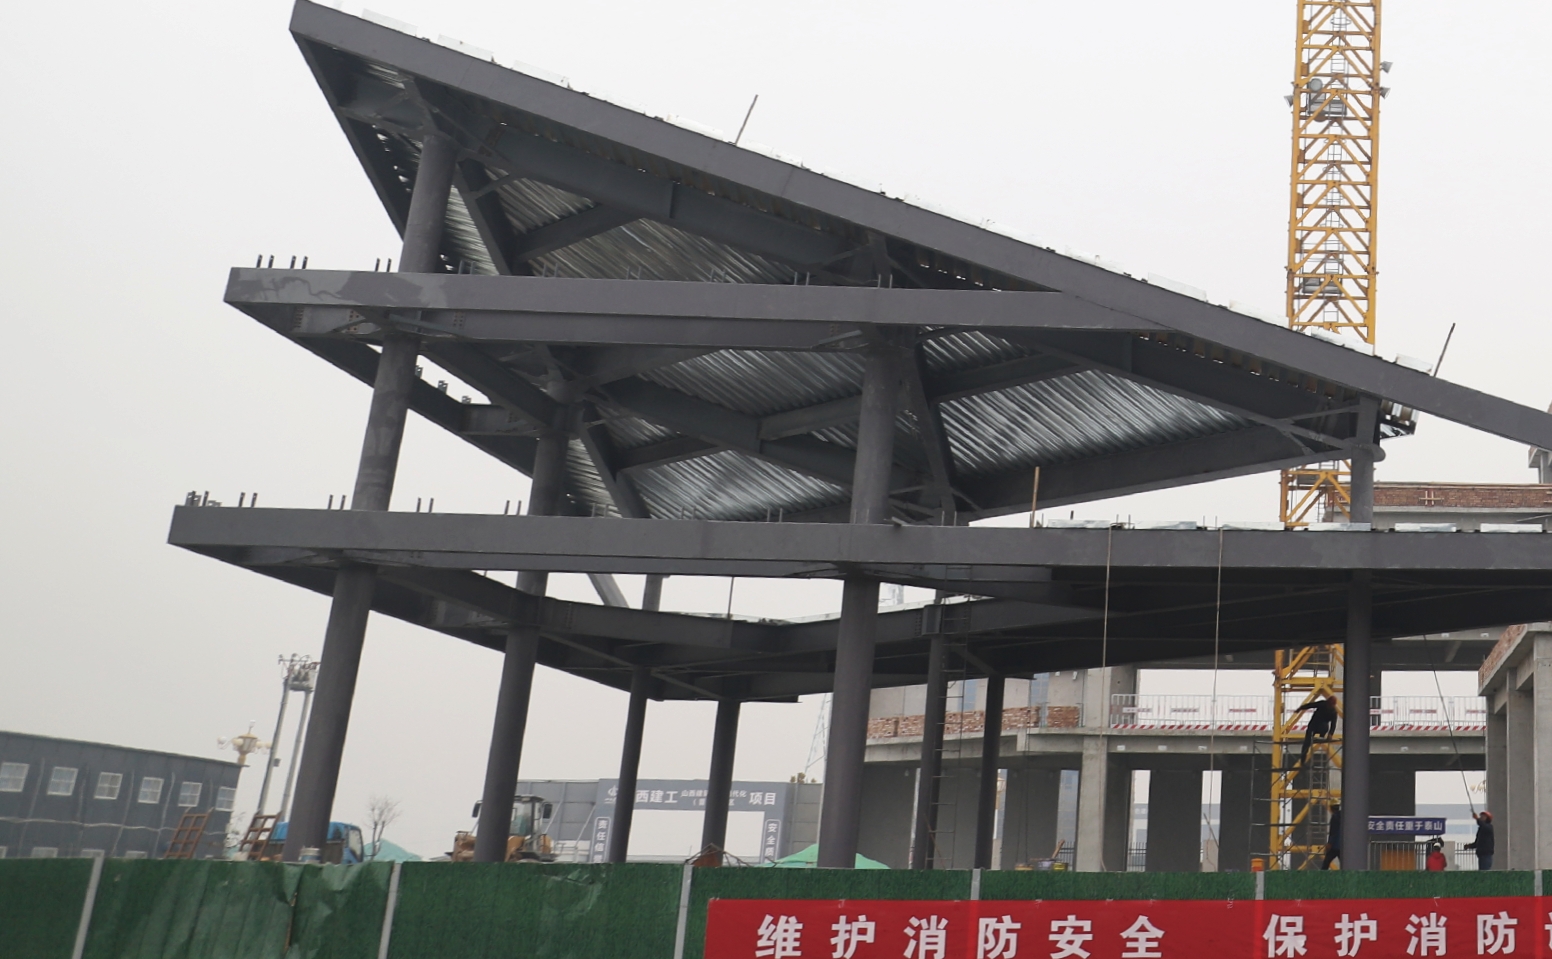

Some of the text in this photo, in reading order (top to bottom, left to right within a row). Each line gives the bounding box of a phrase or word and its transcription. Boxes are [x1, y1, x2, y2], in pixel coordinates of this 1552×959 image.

[749, 792, 777, 806] 项目
[755, 914, 1166, 959] 维护消防安全
